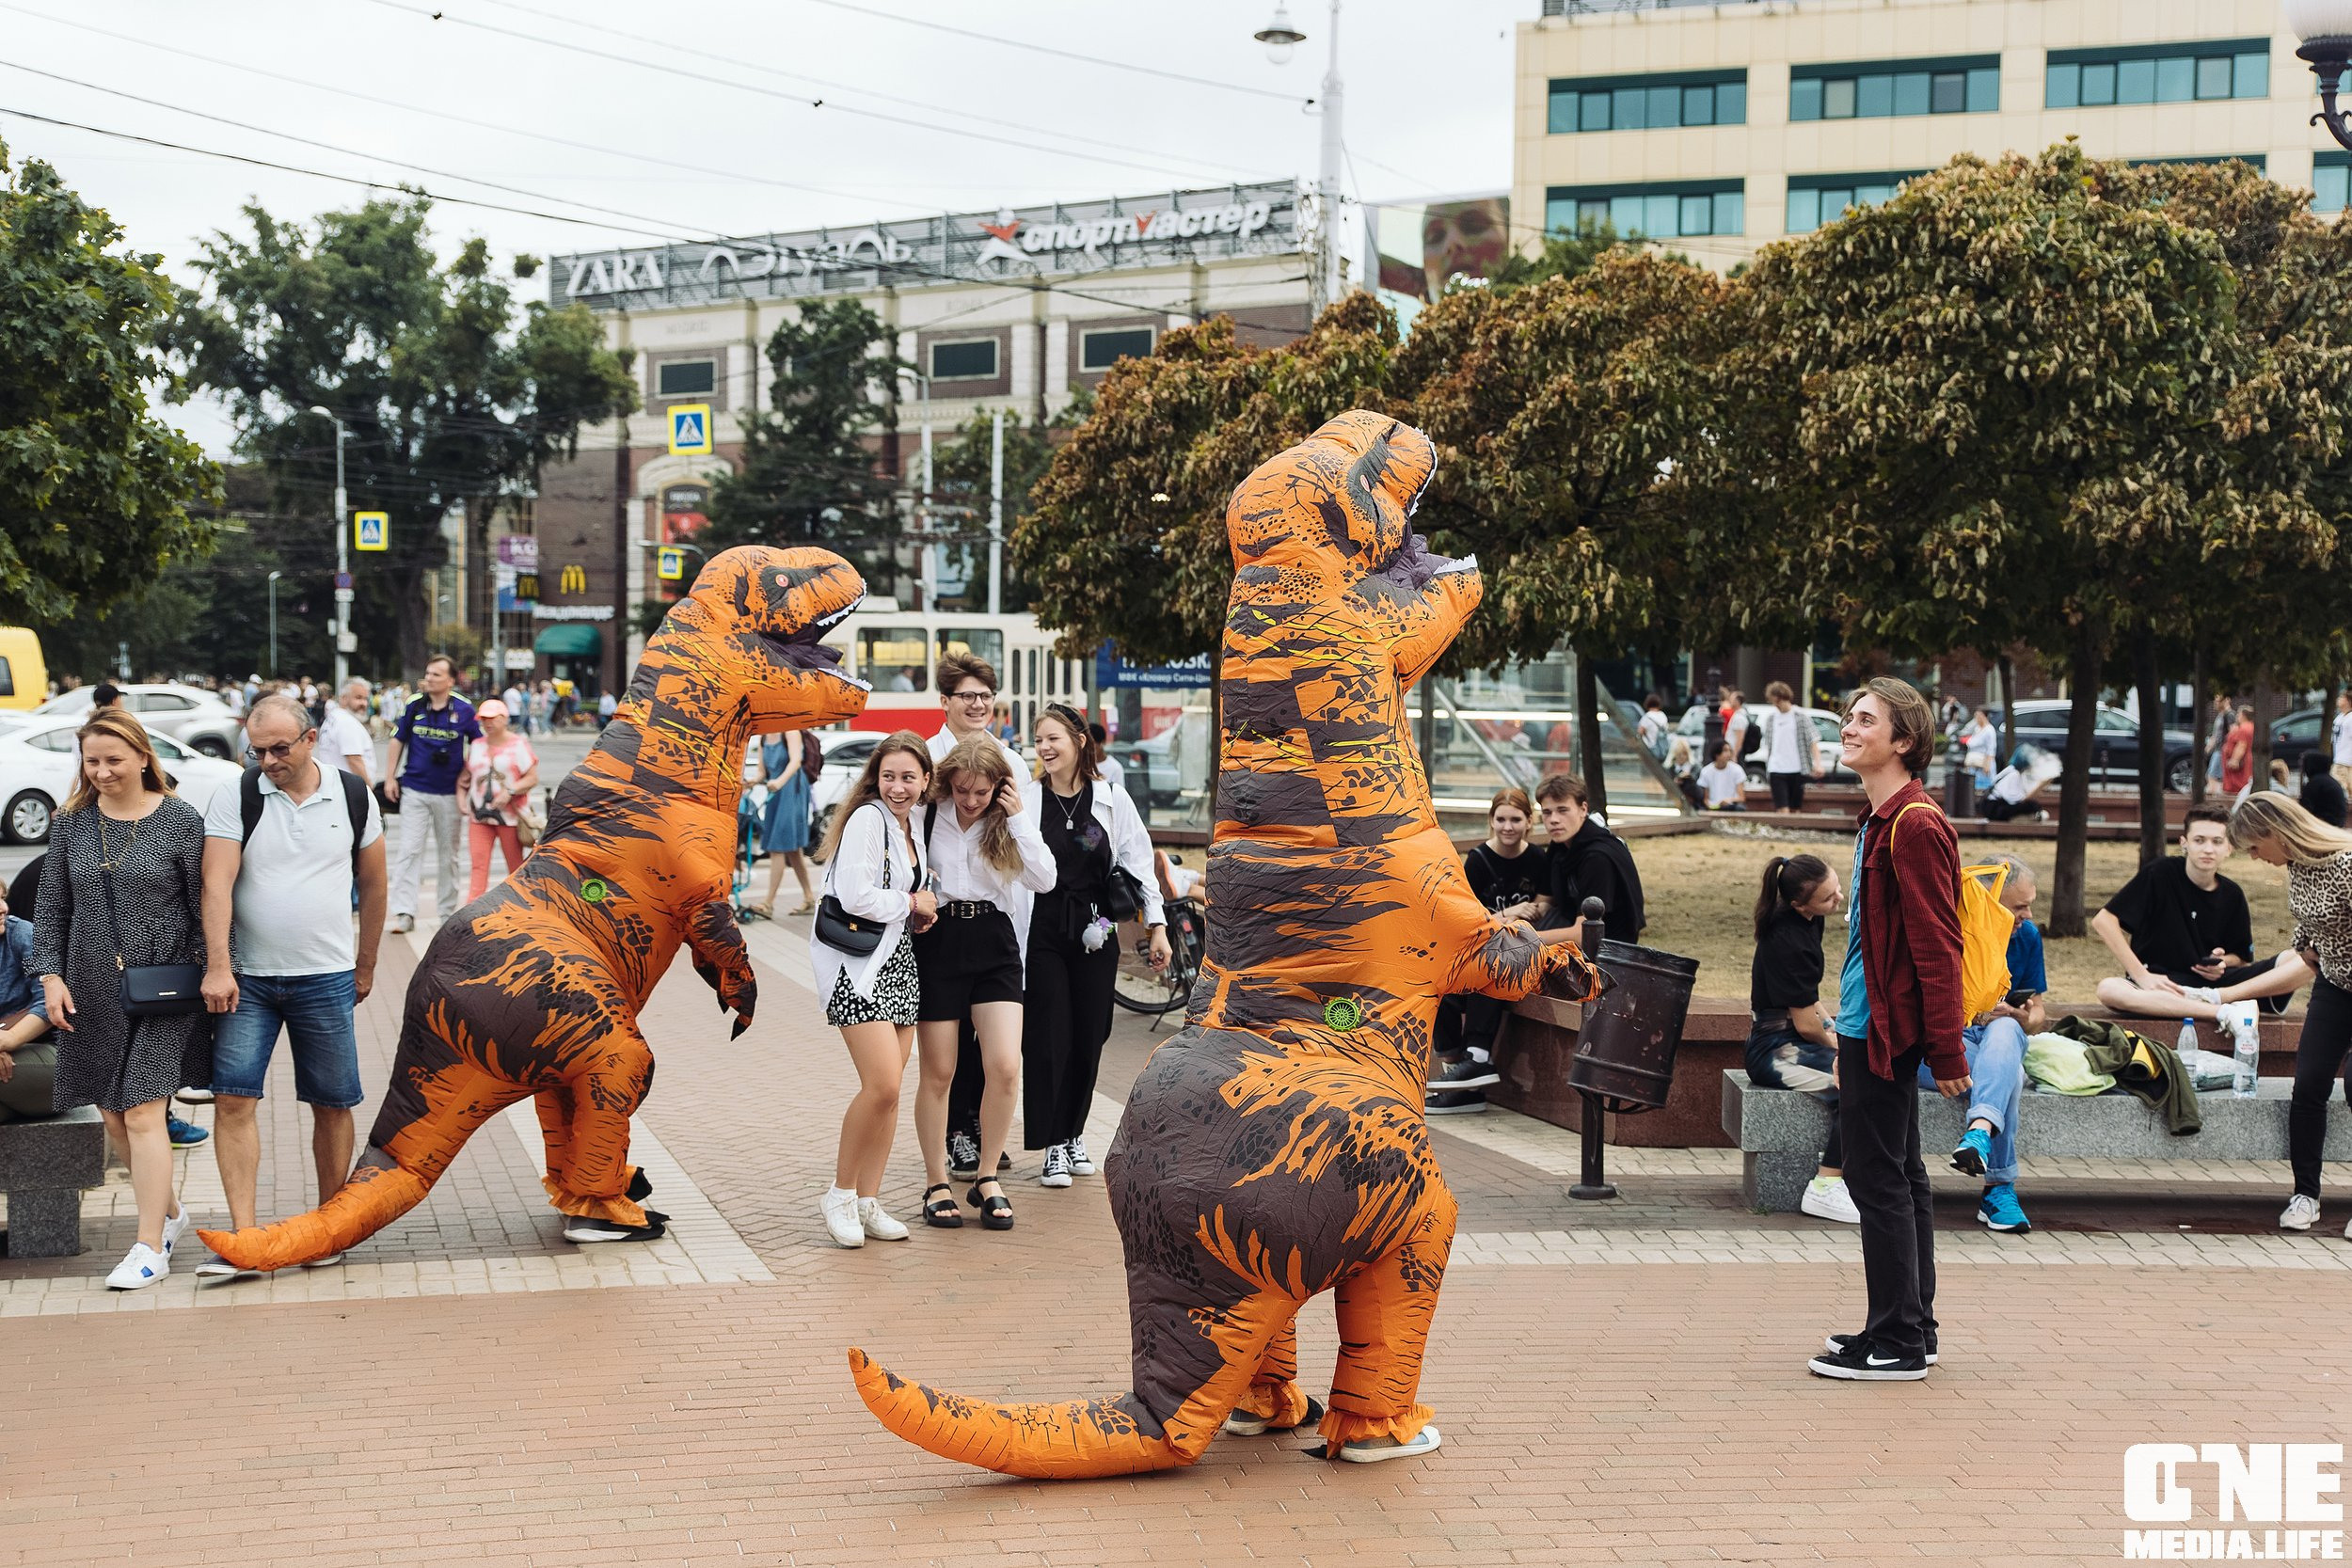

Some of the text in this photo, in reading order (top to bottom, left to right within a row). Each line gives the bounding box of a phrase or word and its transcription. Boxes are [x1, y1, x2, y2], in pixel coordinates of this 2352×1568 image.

[1022, 200, 1271, 255] спортмастер
[564, 253, 664, 296] ZARA
[412, 725, 459, 739] ETIHAD
